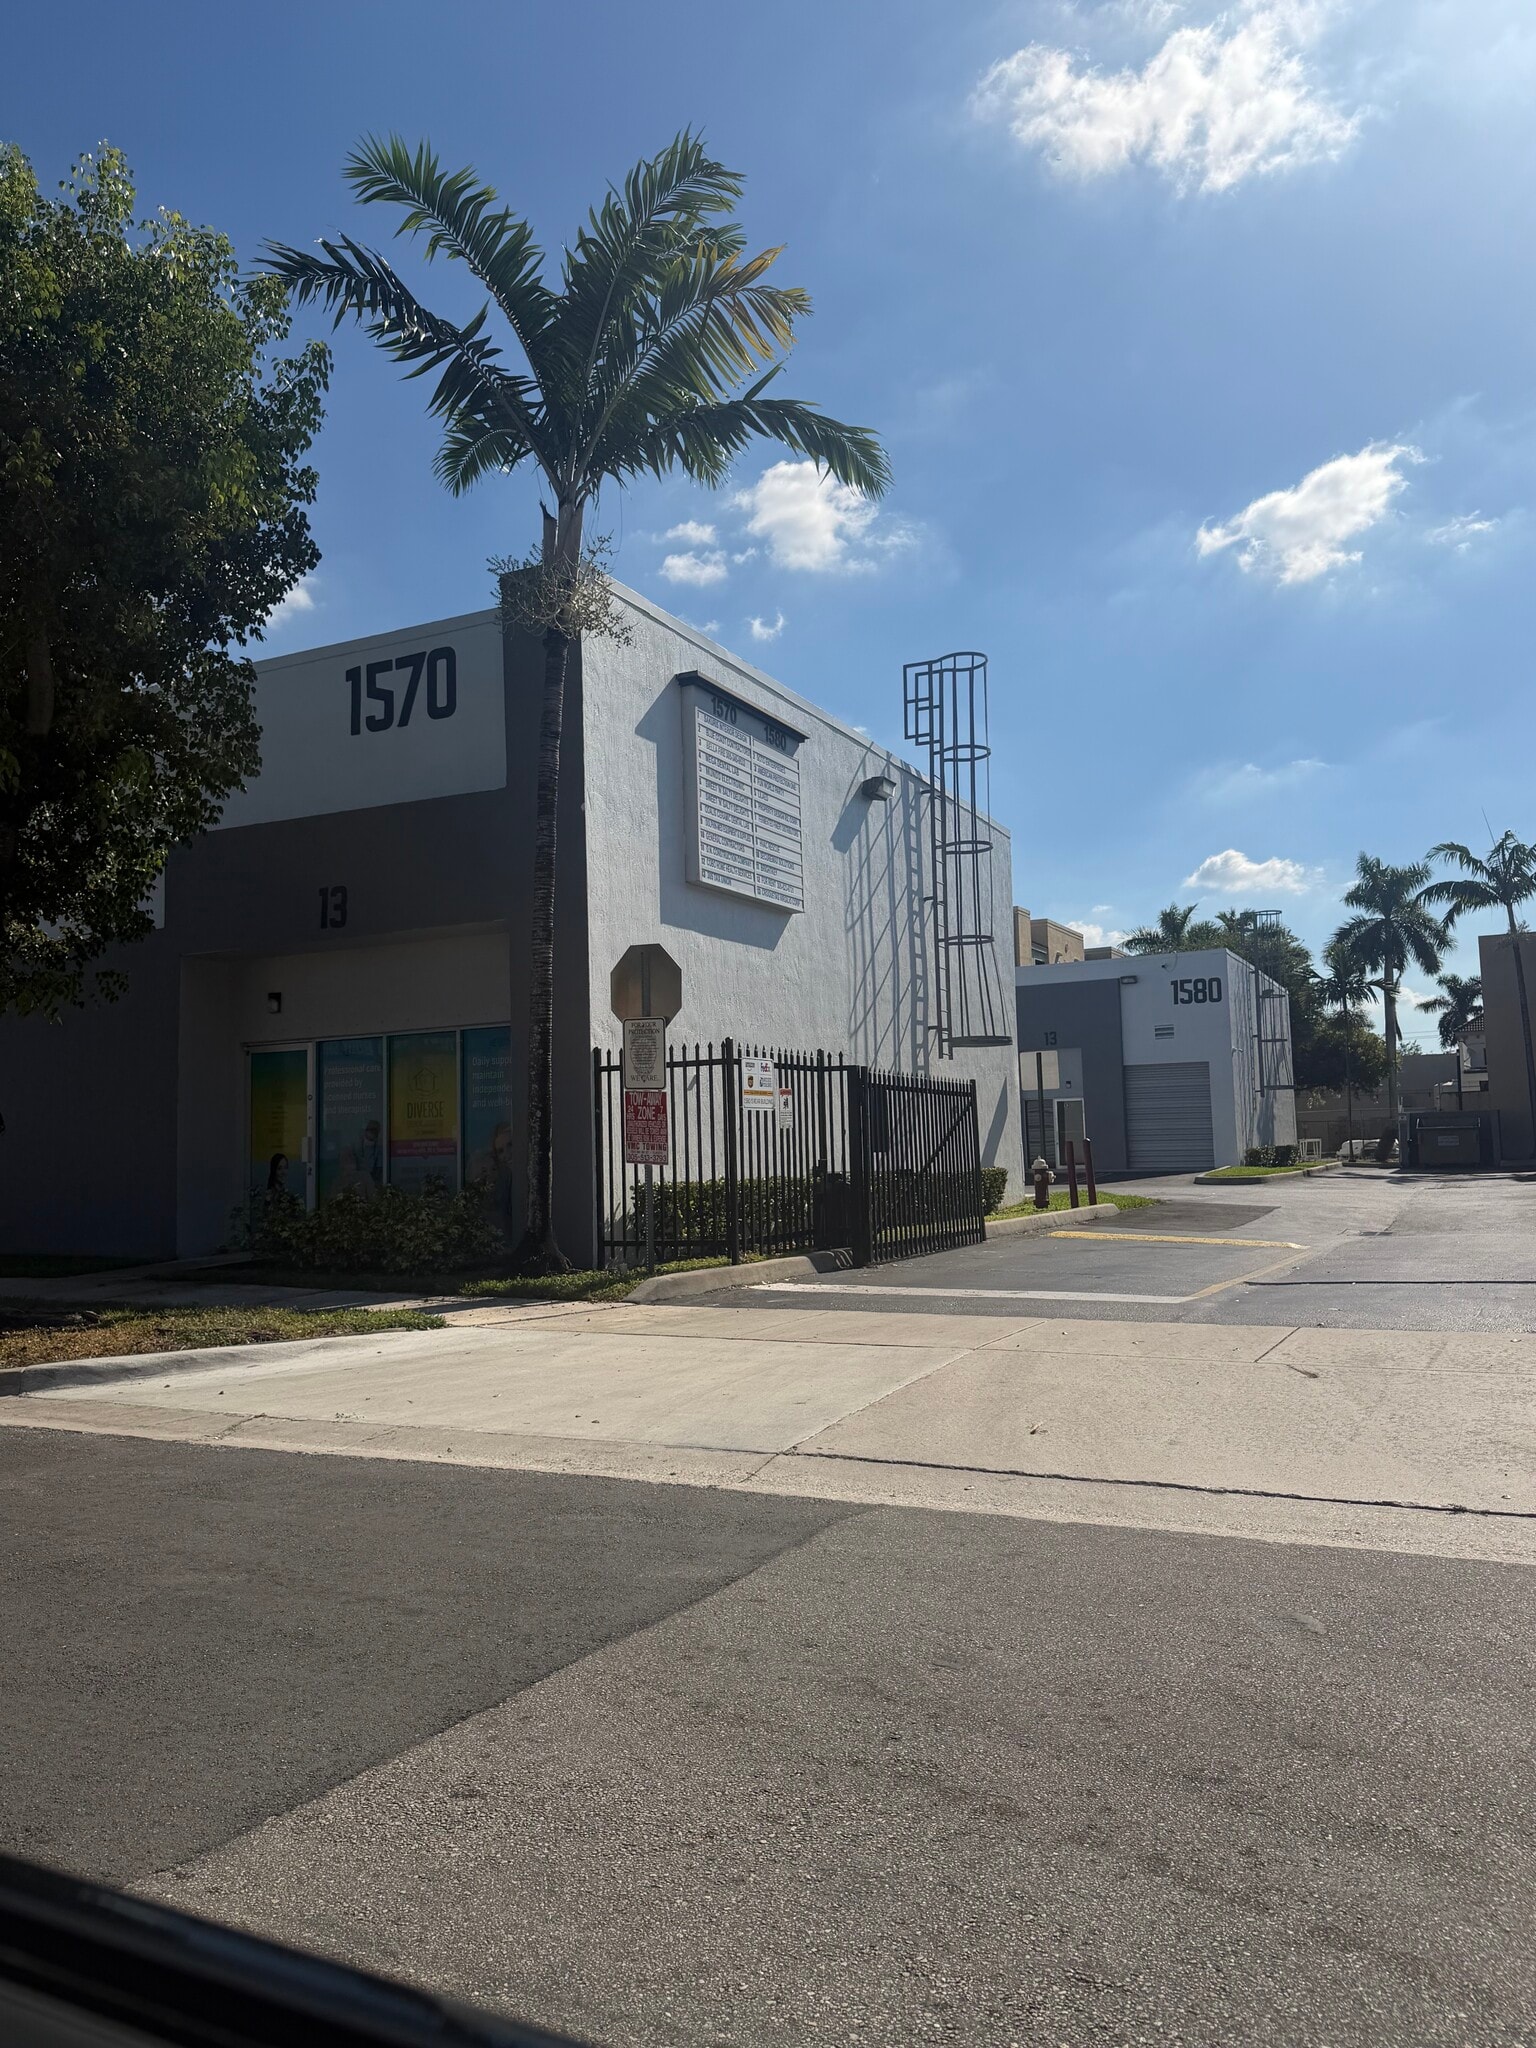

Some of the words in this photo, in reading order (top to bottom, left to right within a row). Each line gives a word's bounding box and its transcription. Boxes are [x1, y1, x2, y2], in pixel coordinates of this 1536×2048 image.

[345, 645, 457, 736] 1570
[711, 696, 737, 724] 1570
[735, 729, 747, 743] DESIGN
[763, 725, 787, 751] 1580
[319, 885, 348, 929] 13
[1170, 977, 1223, 1005] 1580
[1043, 1031, 1058, 1046] 13
[472, 1057, 490, 1068] Daily
[472, 1070, 504, 1080] maintain
[324, 1078, 352, 1088] provided
[354, 1077, 363, 1089] by
[472, 1098, 486, 1108] and
[629, 1092, 663, 1106] TOW-AWAY
[337, 1104, 372, 1115] therapists
[407, 1101, 444, 1119] DIVERSE
[637, 1106, 656, 1120] ZONE
[643, 1142, 667, 1151] TOWING
